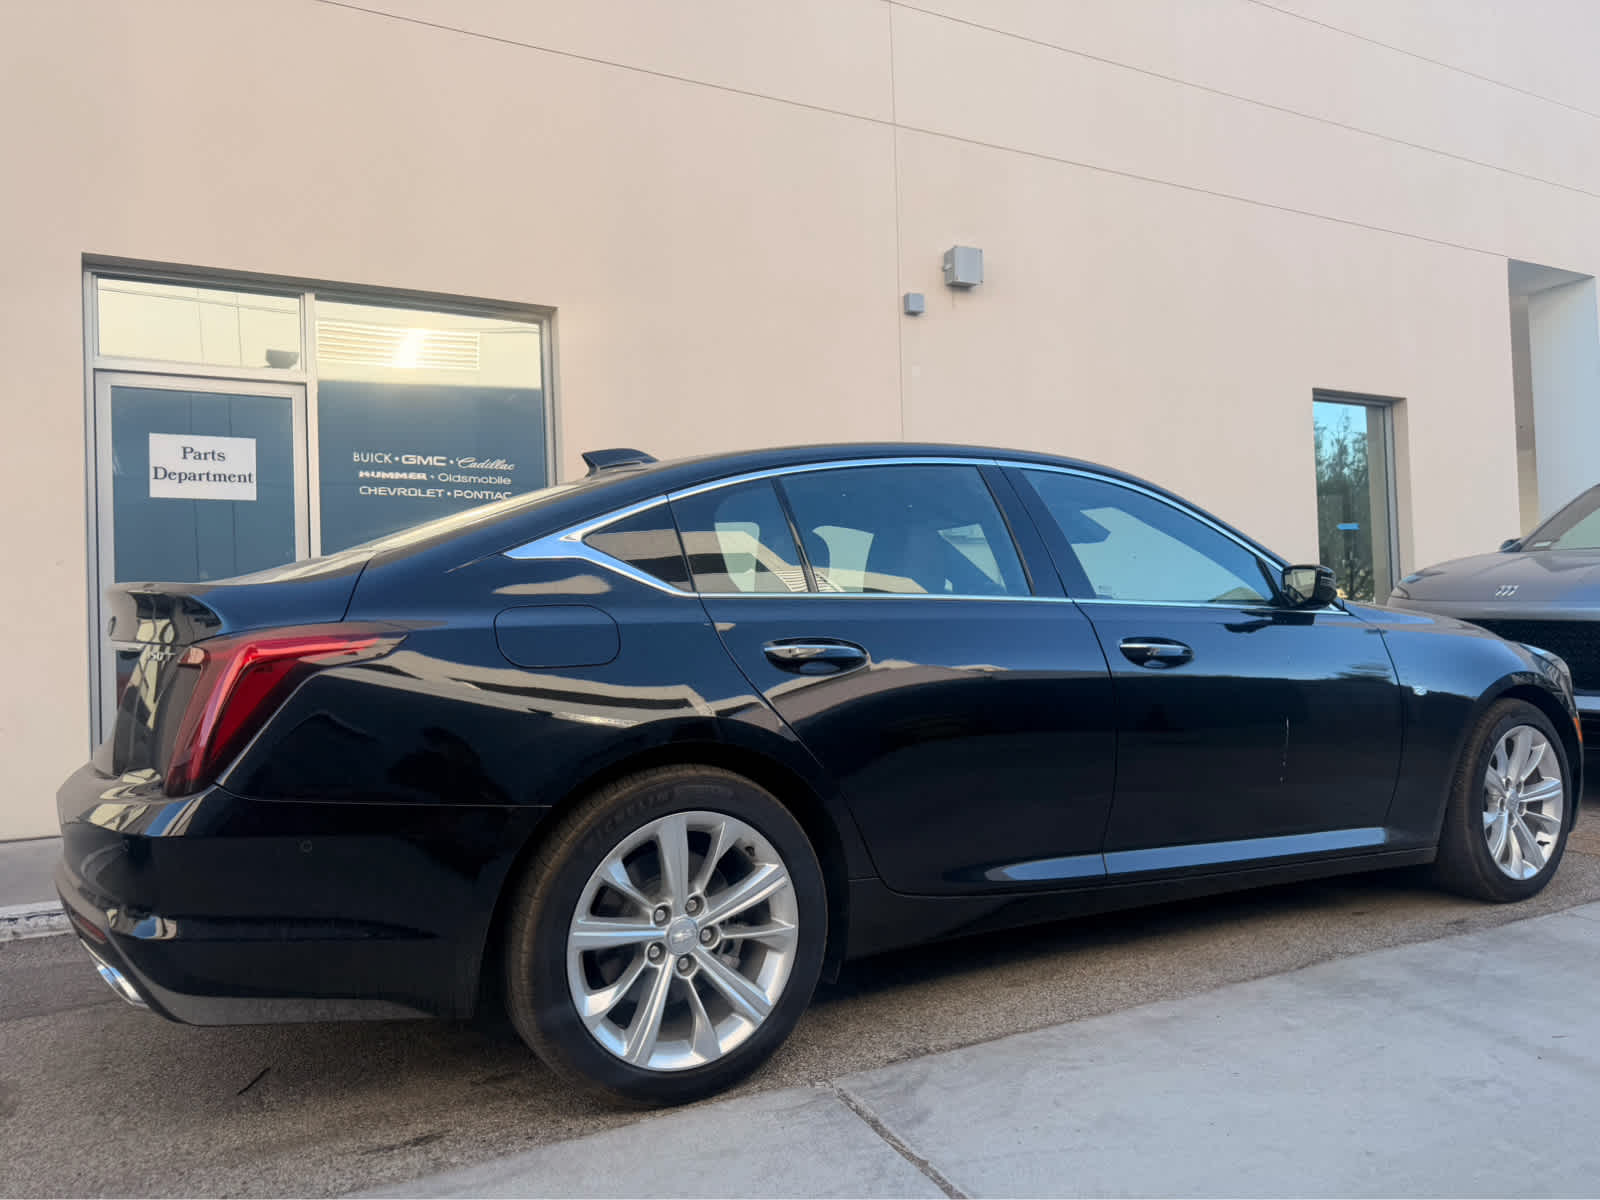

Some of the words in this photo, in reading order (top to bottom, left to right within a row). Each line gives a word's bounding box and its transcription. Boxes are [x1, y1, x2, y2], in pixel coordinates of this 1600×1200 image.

[181, 446, 226, 461] Parts
[353, 452, 392, 463] BUICK
[402, 455, 447, 466] GMC
[456, 457, 515, 471] Cadillac
[152, 466, 254, 483] Department
[359, 471, 428, 481] HUMMER
[438, 473, 512, 485] Oldsmobile
[359, 486, 444, 498] CHEVROLET
[454, 489, 512, 500] PONTIAC
